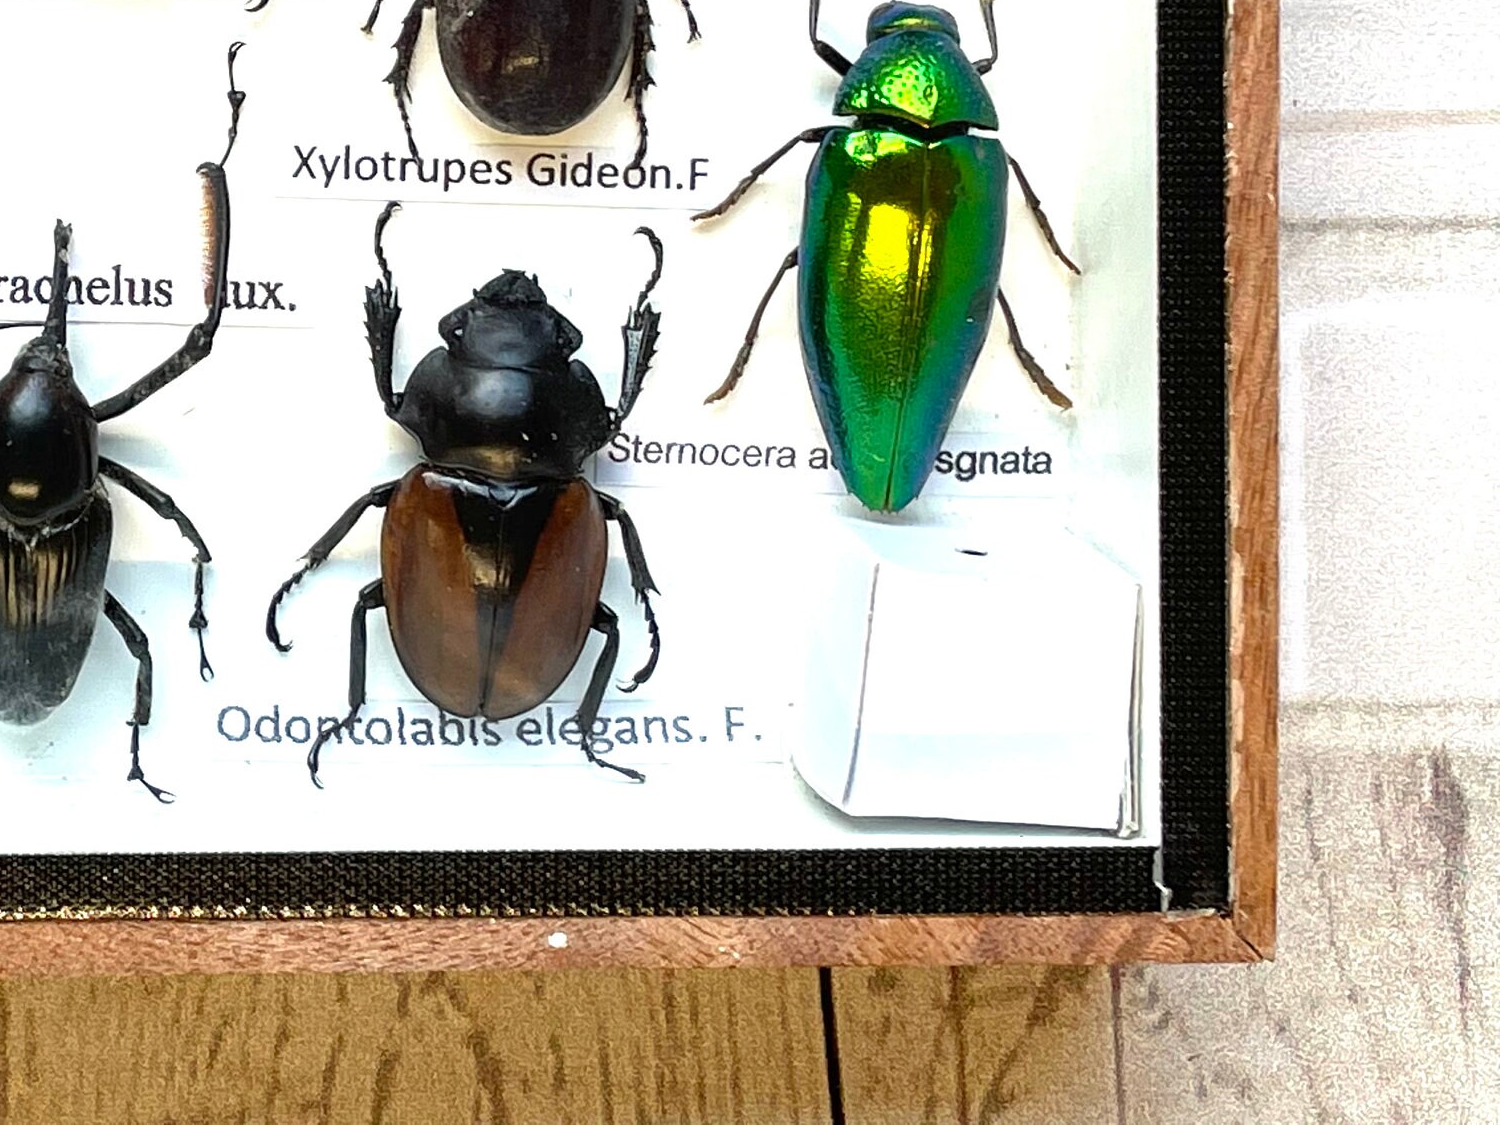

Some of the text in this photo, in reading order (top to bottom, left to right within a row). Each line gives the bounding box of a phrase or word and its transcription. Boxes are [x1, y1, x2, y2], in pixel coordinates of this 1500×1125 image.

[292, 145, 710, 192] Xylotrupes Gideon.F
[607, 434, 797, 469] Sternocera
[217, 704, 762, 754] Odontolabis elegans. F.
